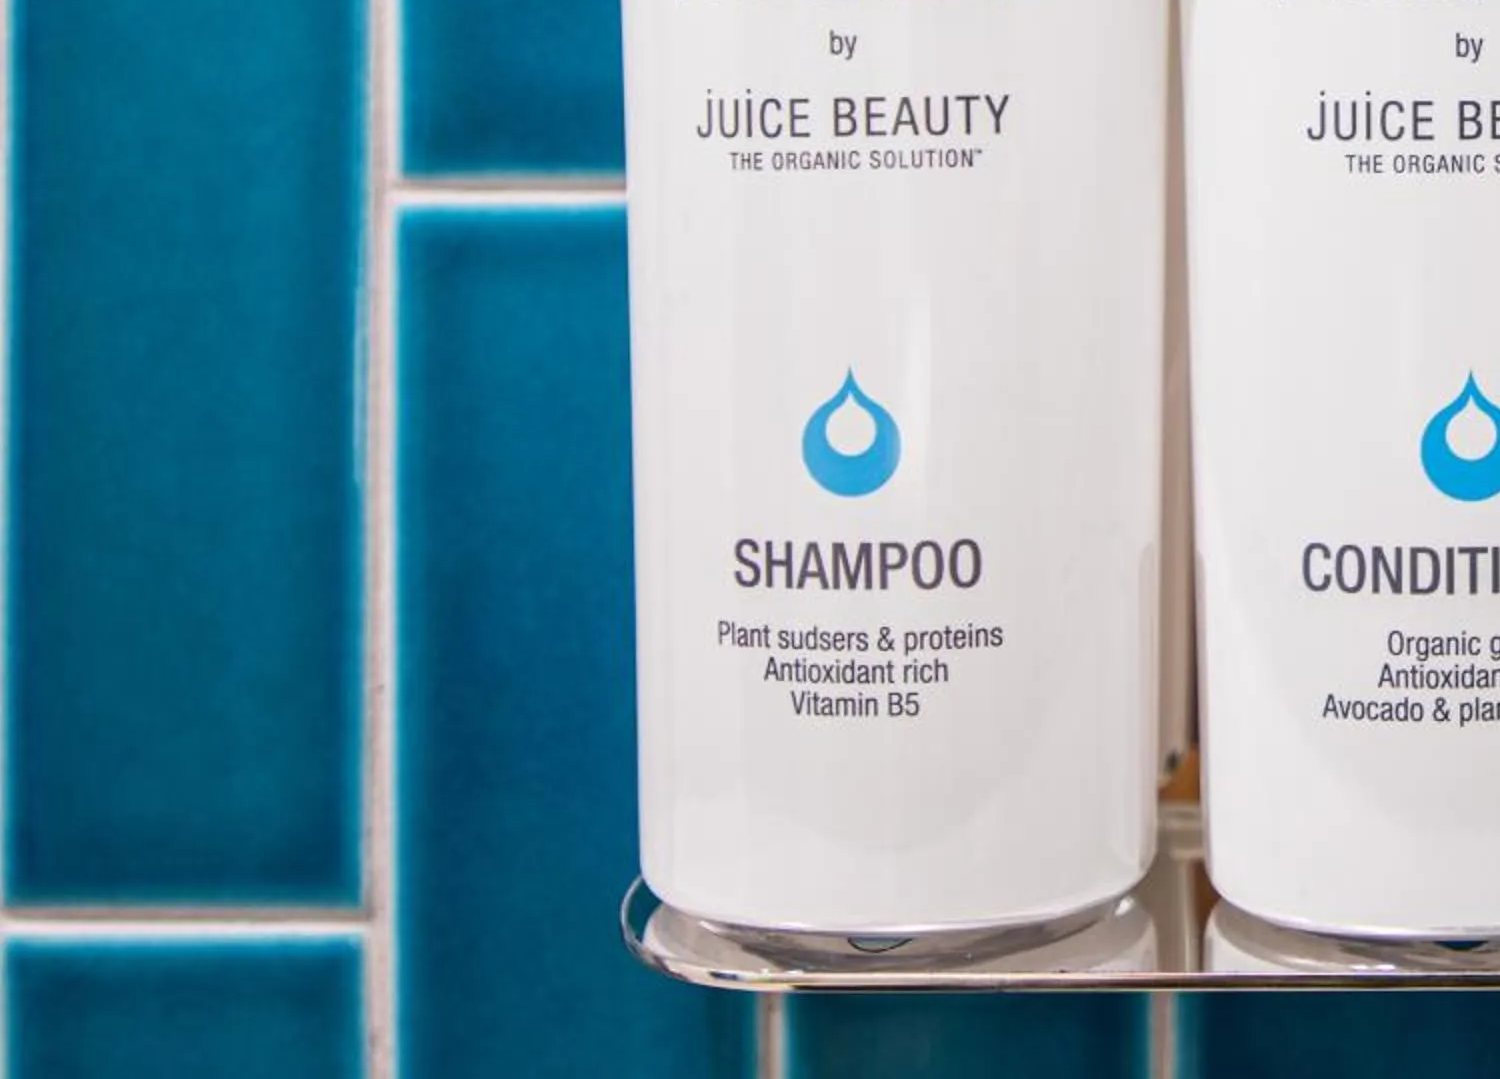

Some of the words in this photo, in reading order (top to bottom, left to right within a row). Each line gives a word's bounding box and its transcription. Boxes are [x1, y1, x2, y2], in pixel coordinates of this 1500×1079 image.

[829, 29, 858, 61] by
[1455, 32, 1484, 65] by
[832, 93, 1010, 138] BEAUTY
[729, 151, 764, 172] THE
[771, 150, 861, 171] ORGANIC
[1343, 153, 1384, 174] THE
[1392, 153, 1486, 175] ORGANIC
[733, 537, 983, 591] SHAMPOO
[717, 620, 772, 650] Plant
[777, 625, 870, 653] sudsers
[876, 625, 896, 653] &
[903, 622, 1004, 657] proteins
[1387, 629, 1482, 663] Organic
[763, 655, 896, 685] Antioxidant
[903, 657, 949, 684] rich
[789, 690, 879, 718] Vitamin
[887, 691, 921, 718] B5
[1321, 692, 1425, 723] Avocado
[1431, 696, 1452, 723] &
